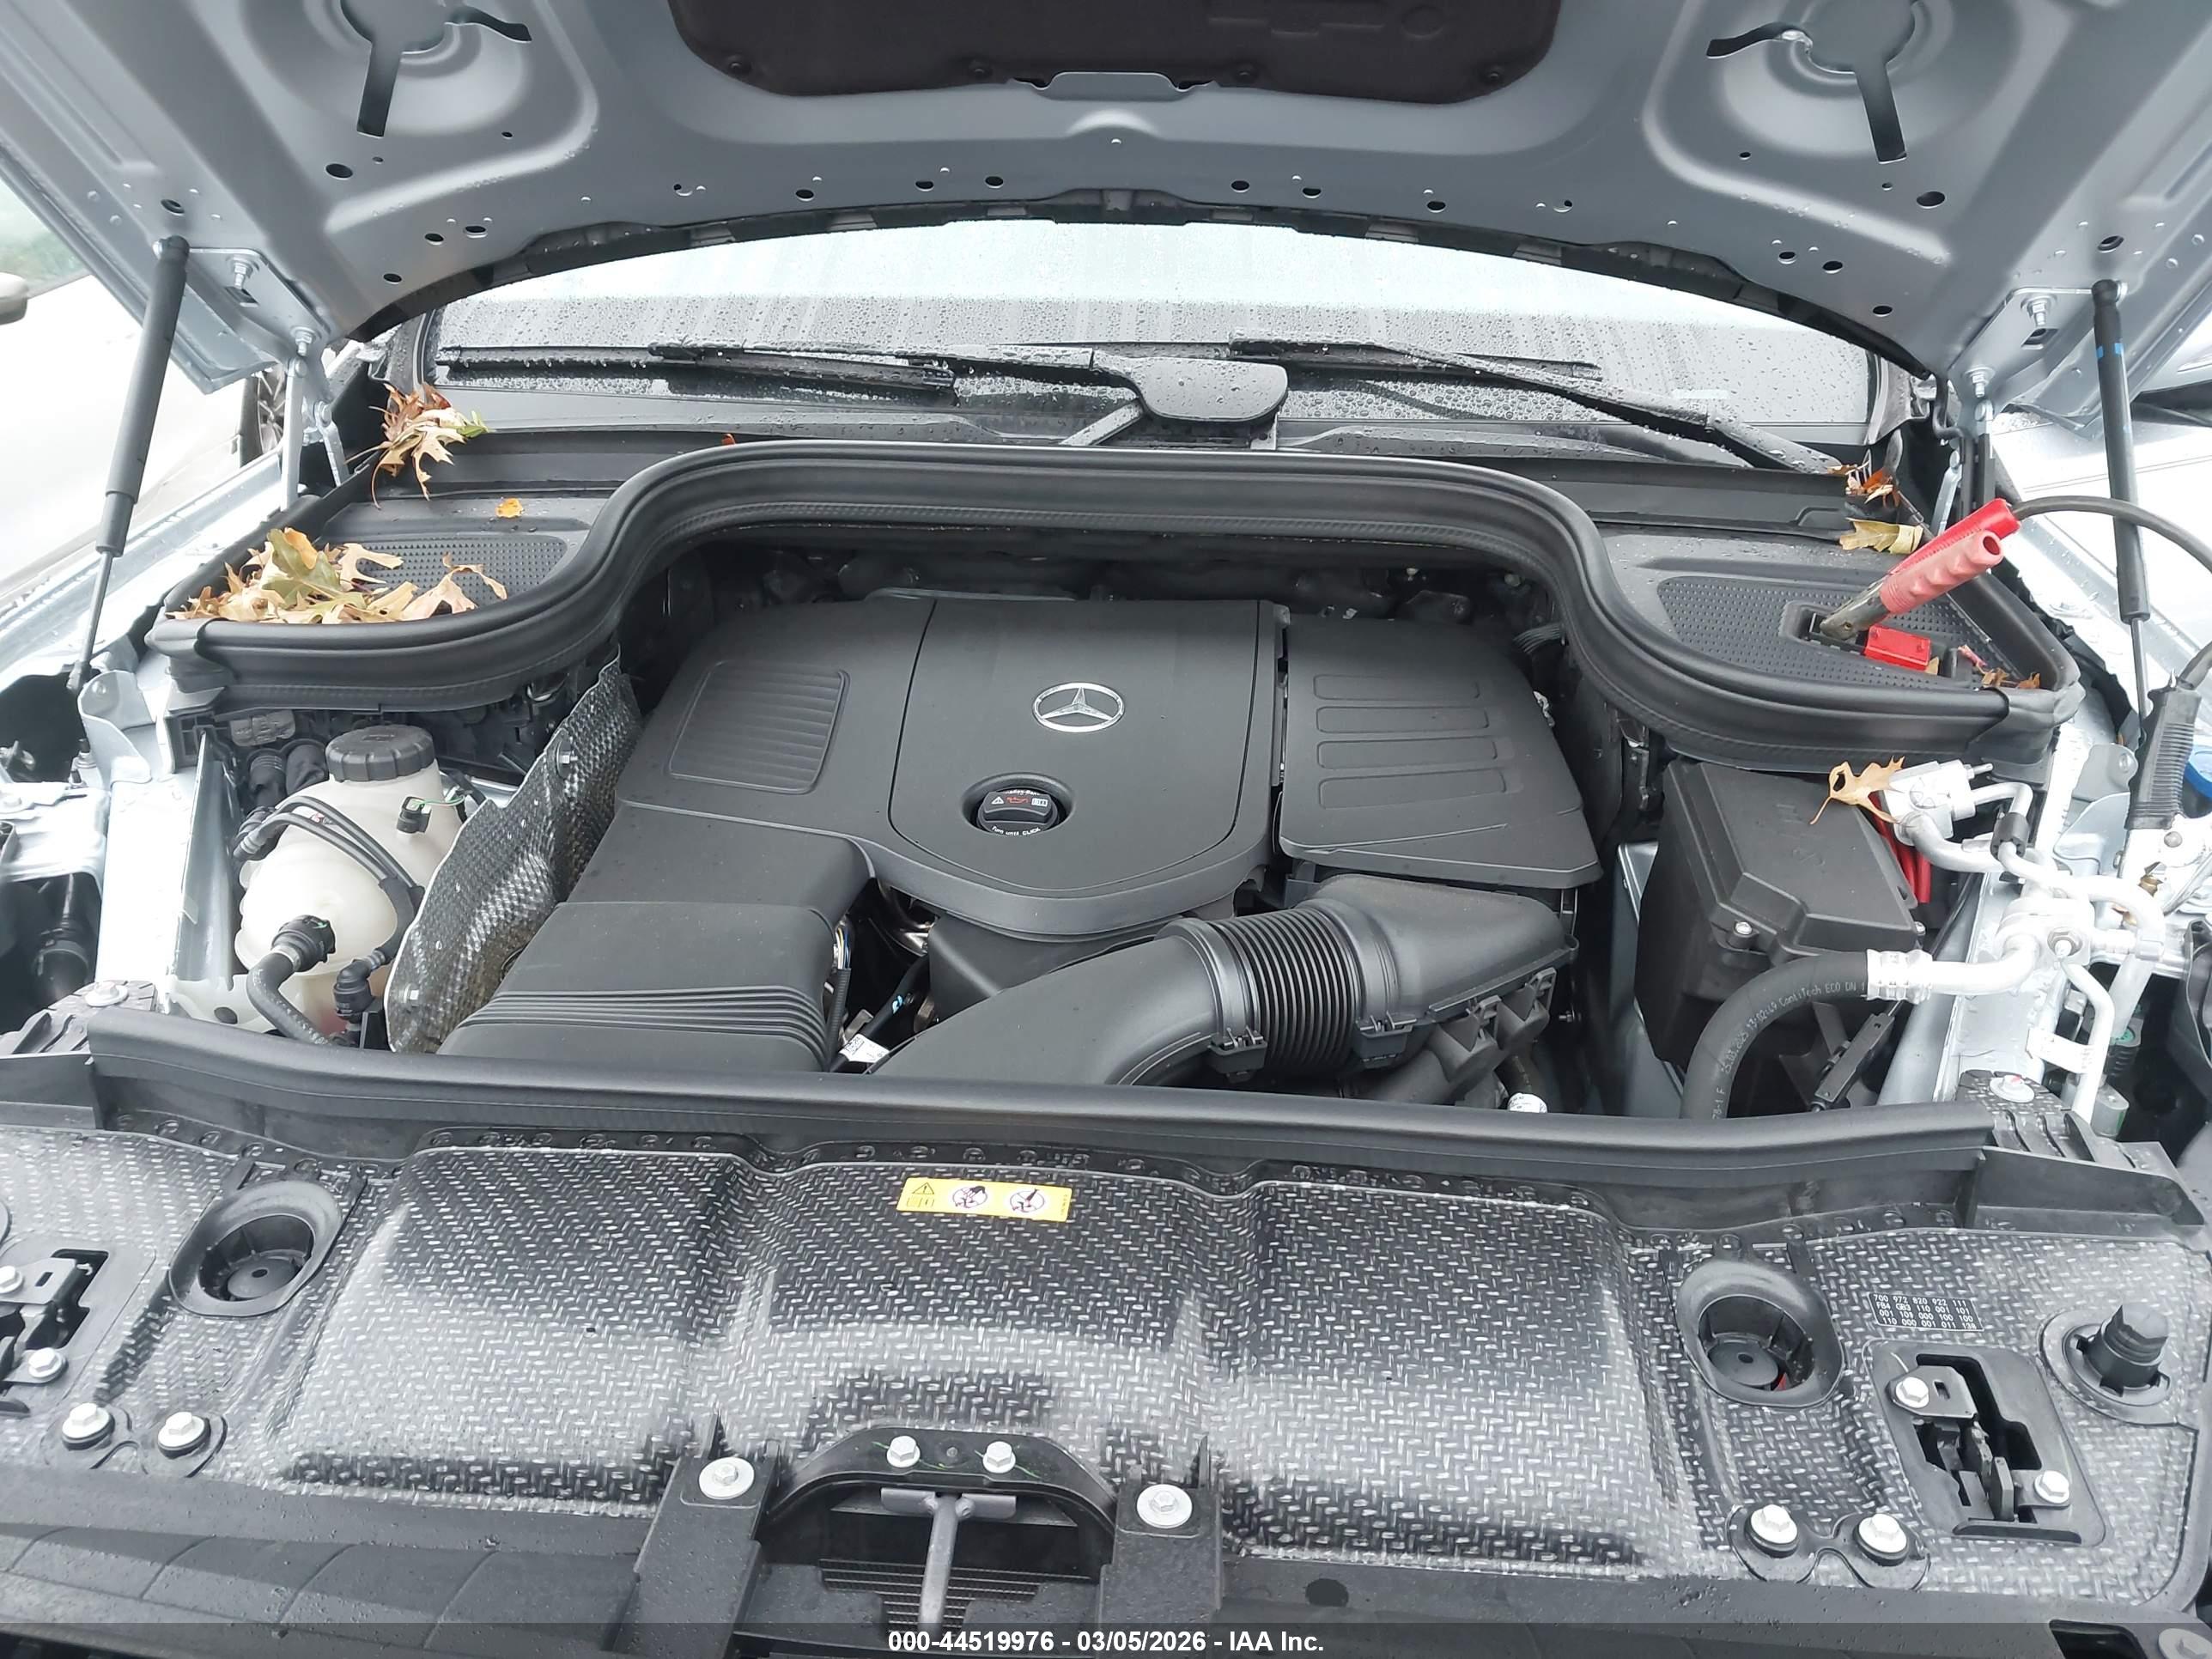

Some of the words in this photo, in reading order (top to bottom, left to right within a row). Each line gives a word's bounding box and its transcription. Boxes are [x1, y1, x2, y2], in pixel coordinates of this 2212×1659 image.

[1022, 827, 1041, 836] CLICK
[1778, 985, 1822, 1009] ContiTech
[1825, 981, 1842, 994] ECO
